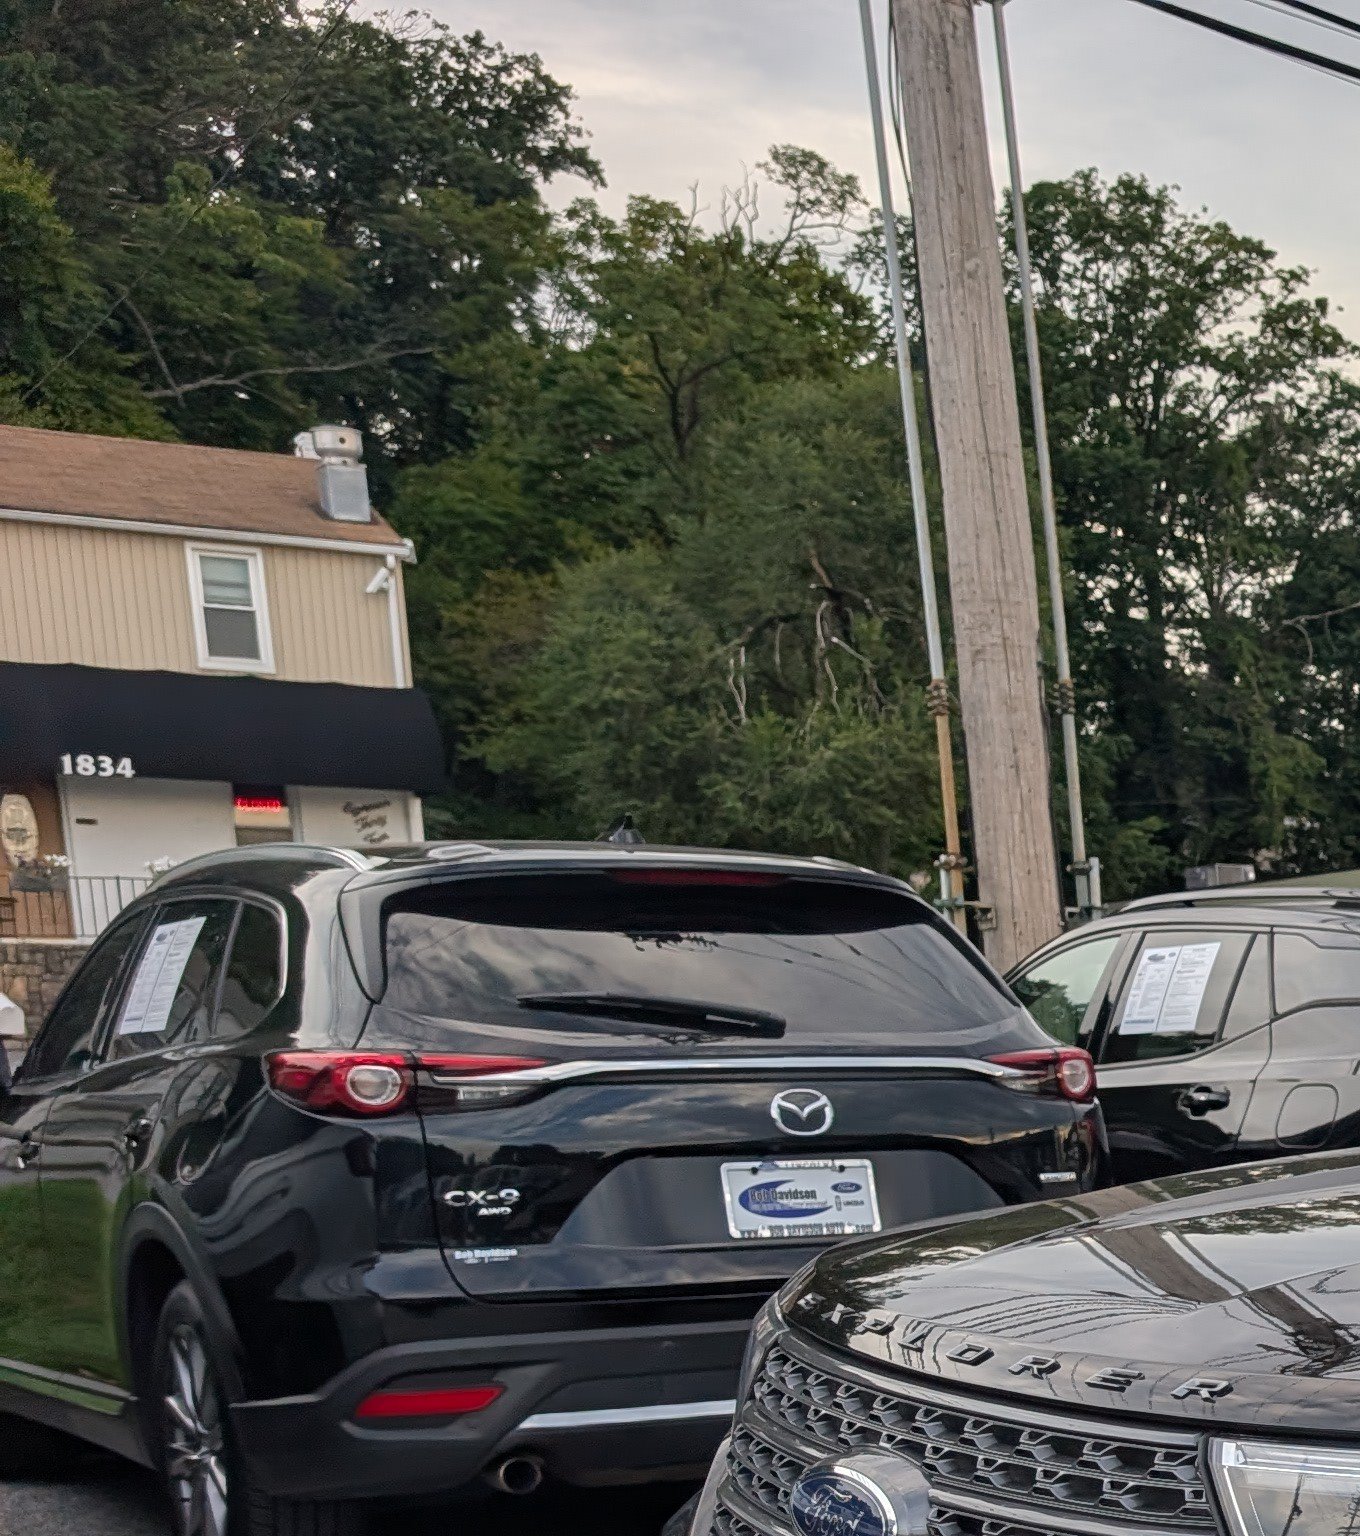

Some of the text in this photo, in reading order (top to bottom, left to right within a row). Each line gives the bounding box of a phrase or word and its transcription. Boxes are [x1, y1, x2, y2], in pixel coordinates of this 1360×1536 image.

[60, 752, 136, 779] 1834
[444, 1188, 520, 1207] CX-9
[750, 1187, 817, 1201] Bob Davidson
[479, 1206, 512, 1215] AWD
[798, 1292, 1235, 1403] EXPLORER
